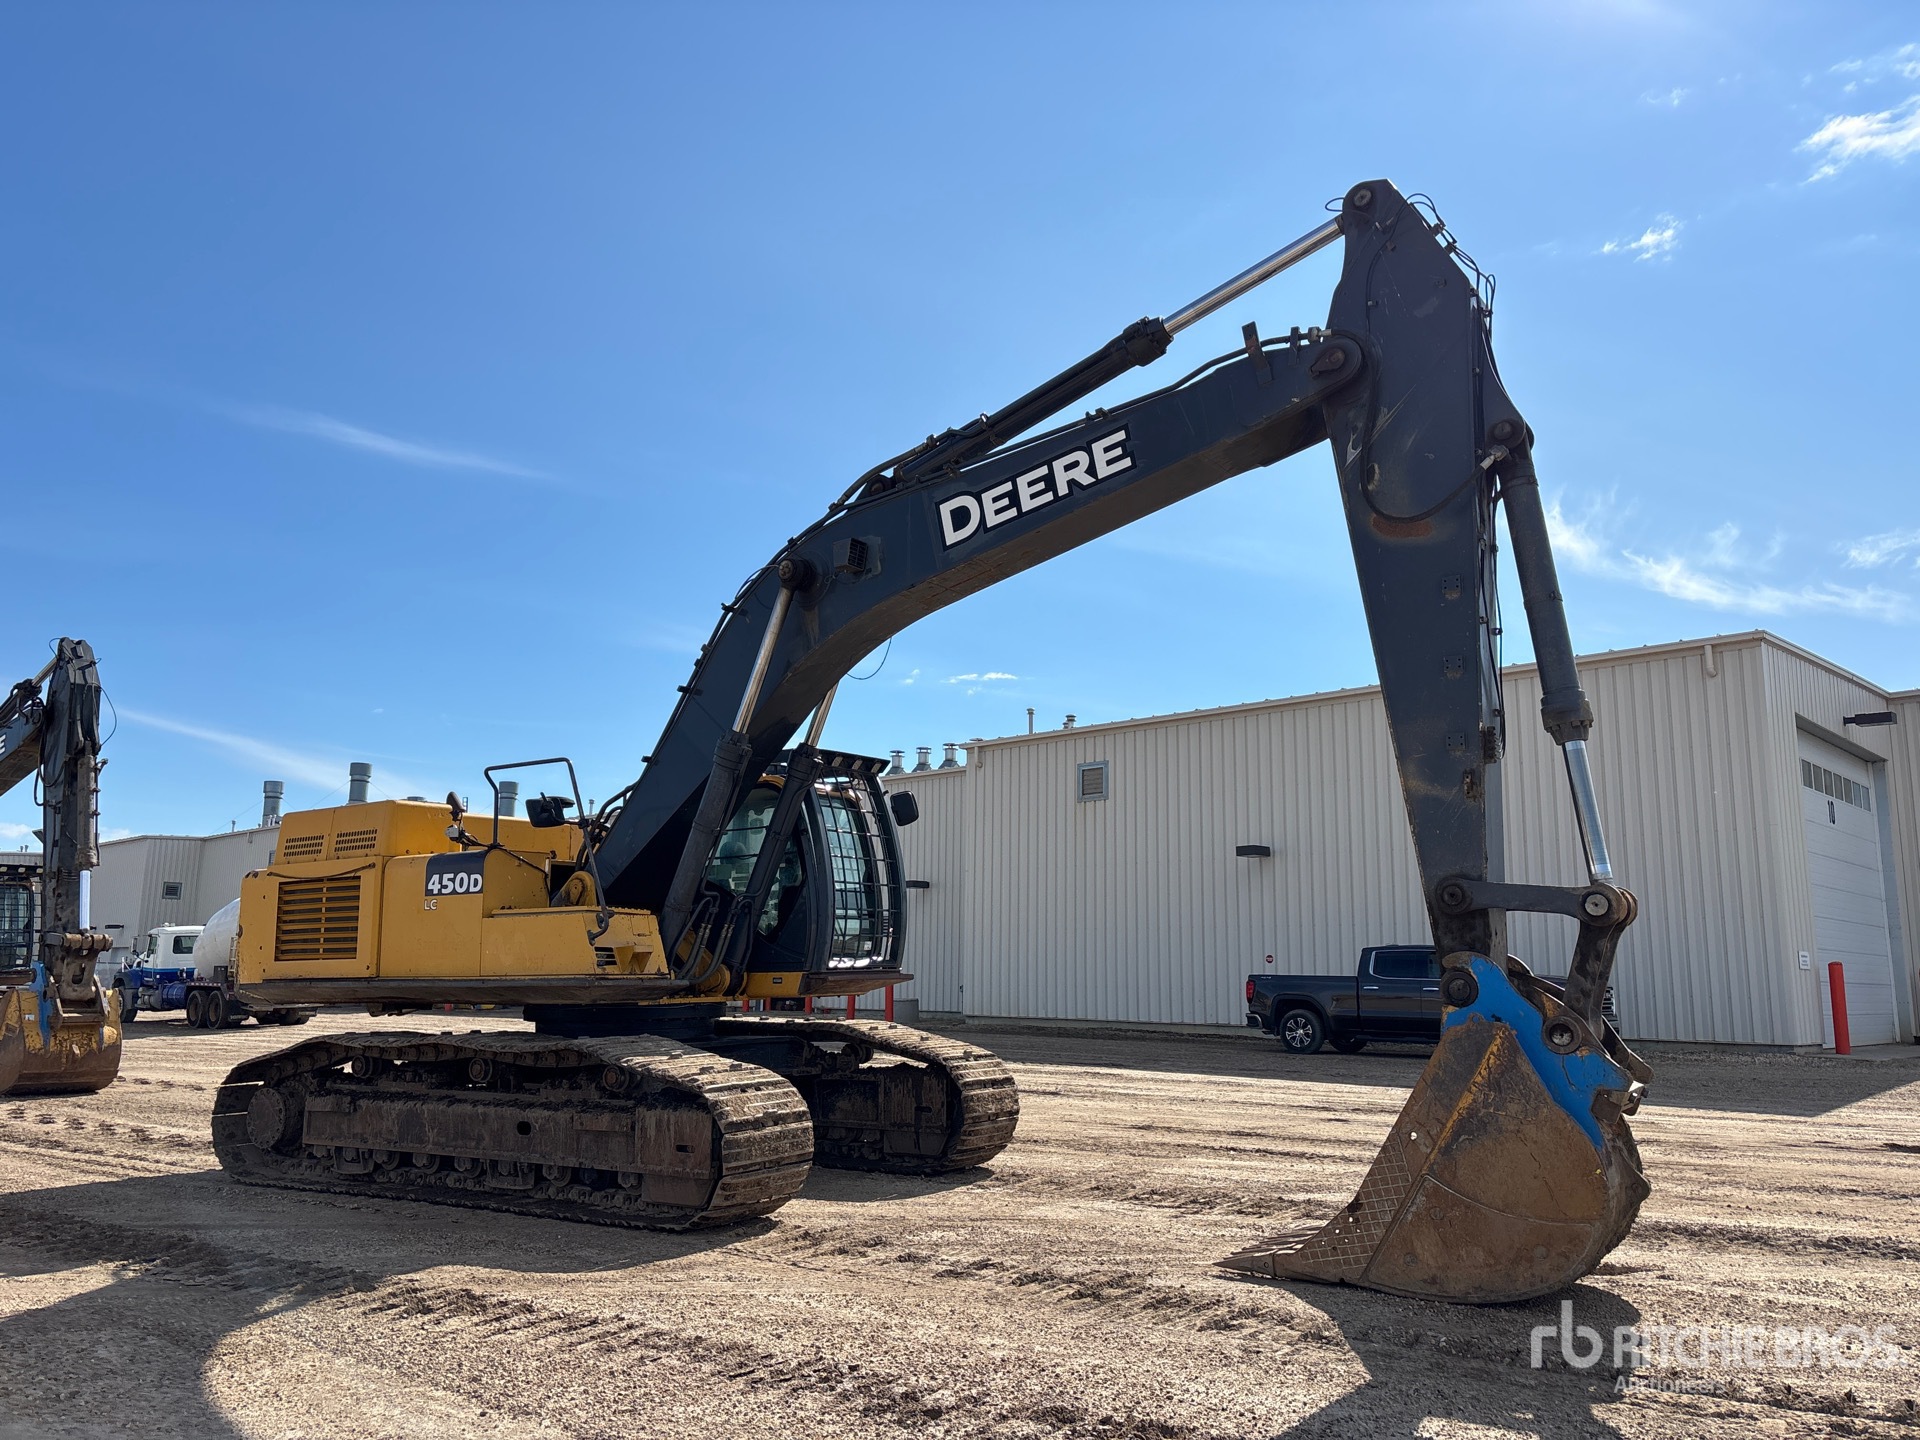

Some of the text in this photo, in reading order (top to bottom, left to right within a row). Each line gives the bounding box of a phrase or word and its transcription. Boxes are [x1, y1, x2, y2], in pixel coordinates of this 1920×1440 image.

[939, 429, 1133, 547] DEERE
[1827, 799, 1836, 825] 10
[427, 872, 483, 895] 450D
[424, 899, 437, 910] LC
